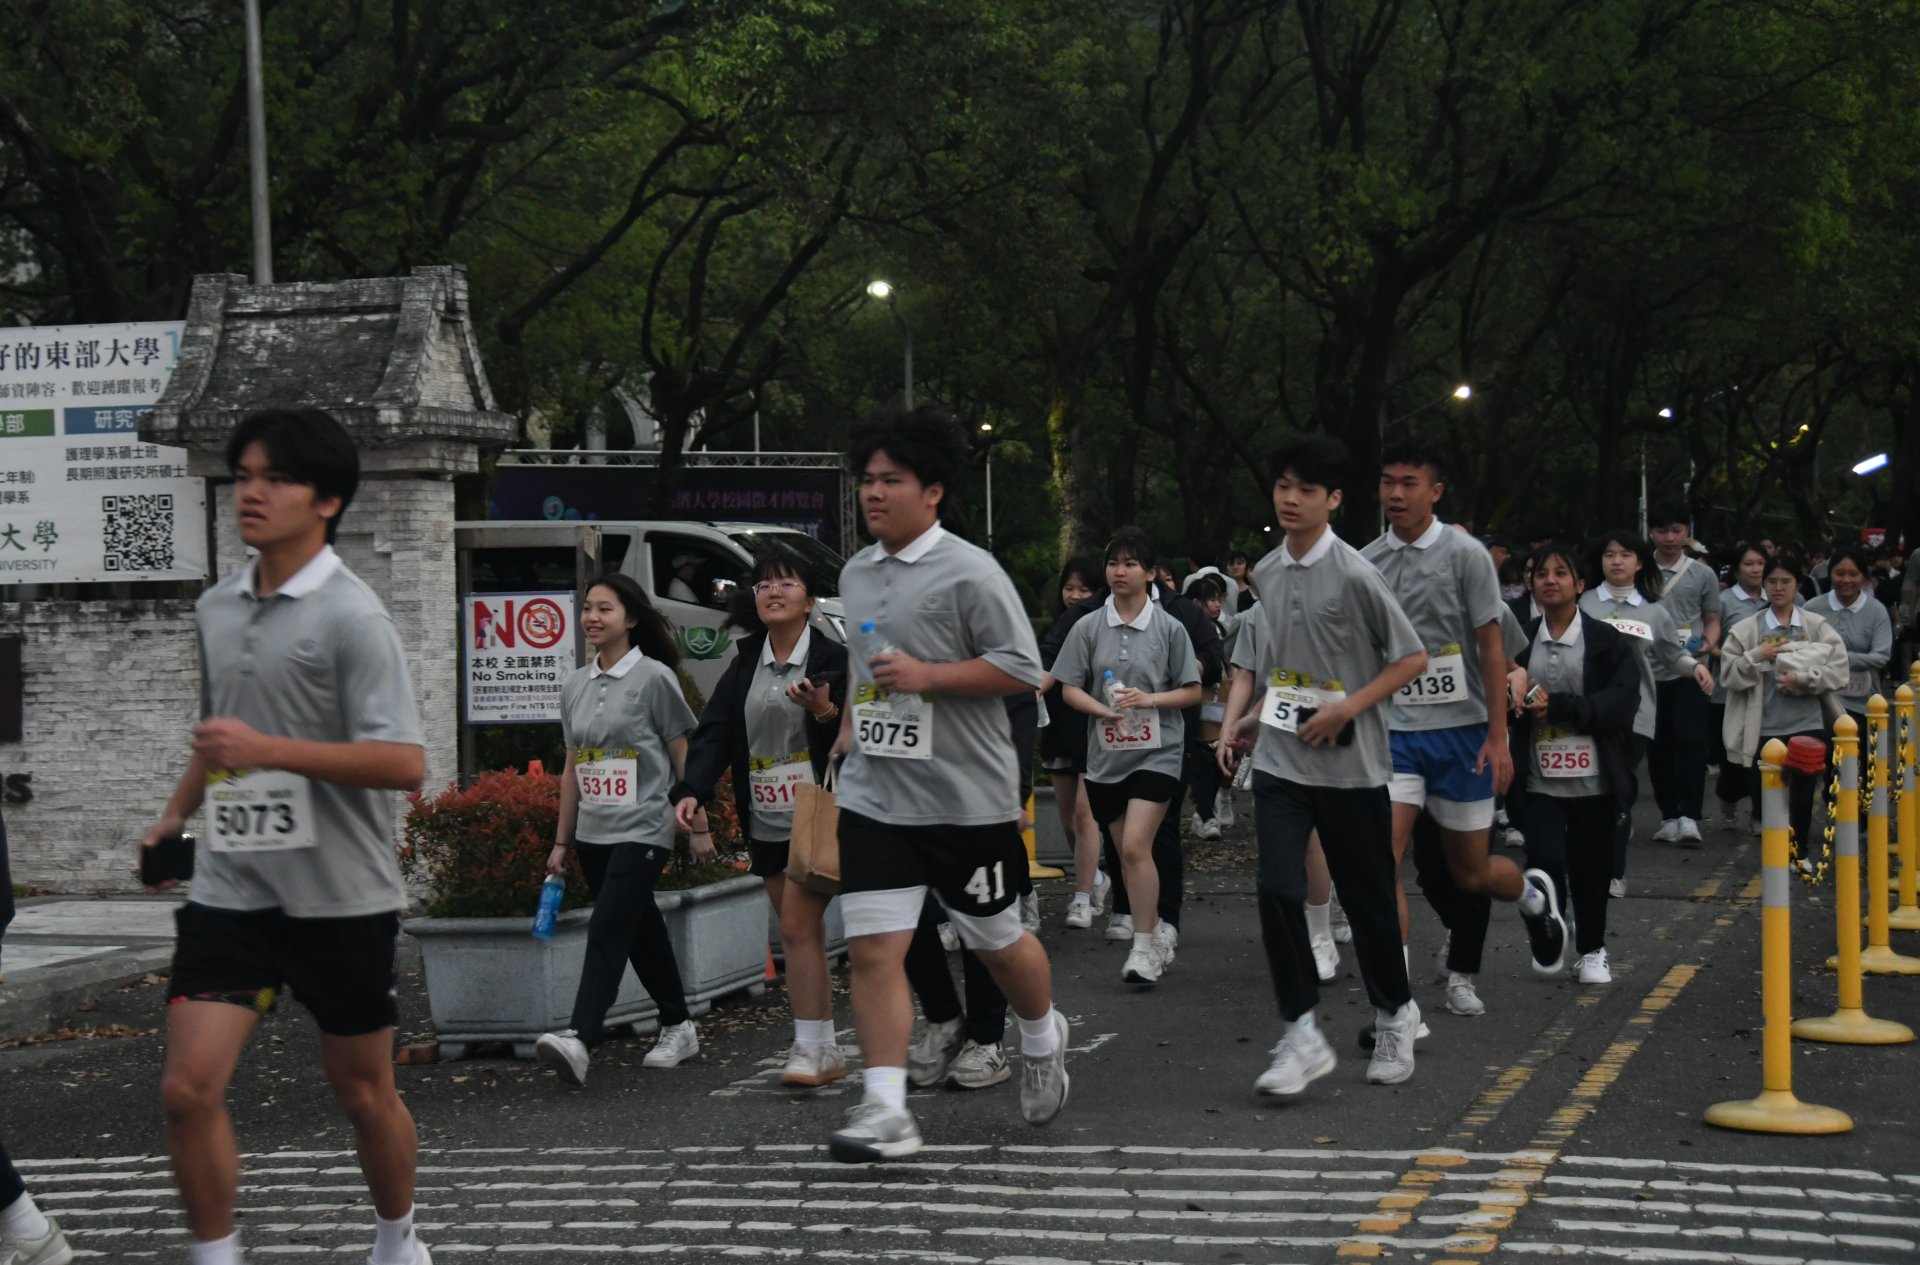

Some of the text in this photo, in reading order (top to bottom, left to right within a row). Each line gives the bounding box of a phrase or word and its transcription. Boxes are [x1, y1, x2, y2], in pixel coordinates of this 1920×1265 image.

[0, 413, 25, 434] 部
[94, 408, 153, 430] 研究
[66, 464, 191, 482] 長期照護研究所碩士
[0, 490, 30, 505] 學系
[0, 520, 59, 552] 大學
[472, 655, 556, 669] 本校 全面禁菸
[472, 670, 556, 682] No Smoking
[472, 703, 509, 711] Maximum
[511, 702, 527, 711] Fine
[859, 719, 919, 748] 5075
[1541, 752, 1590, 769] 5256
[582, 776, 627, 797] 5318
[216, 802, 297, 836] 5073
[964, 860, 1006, 905] 41
